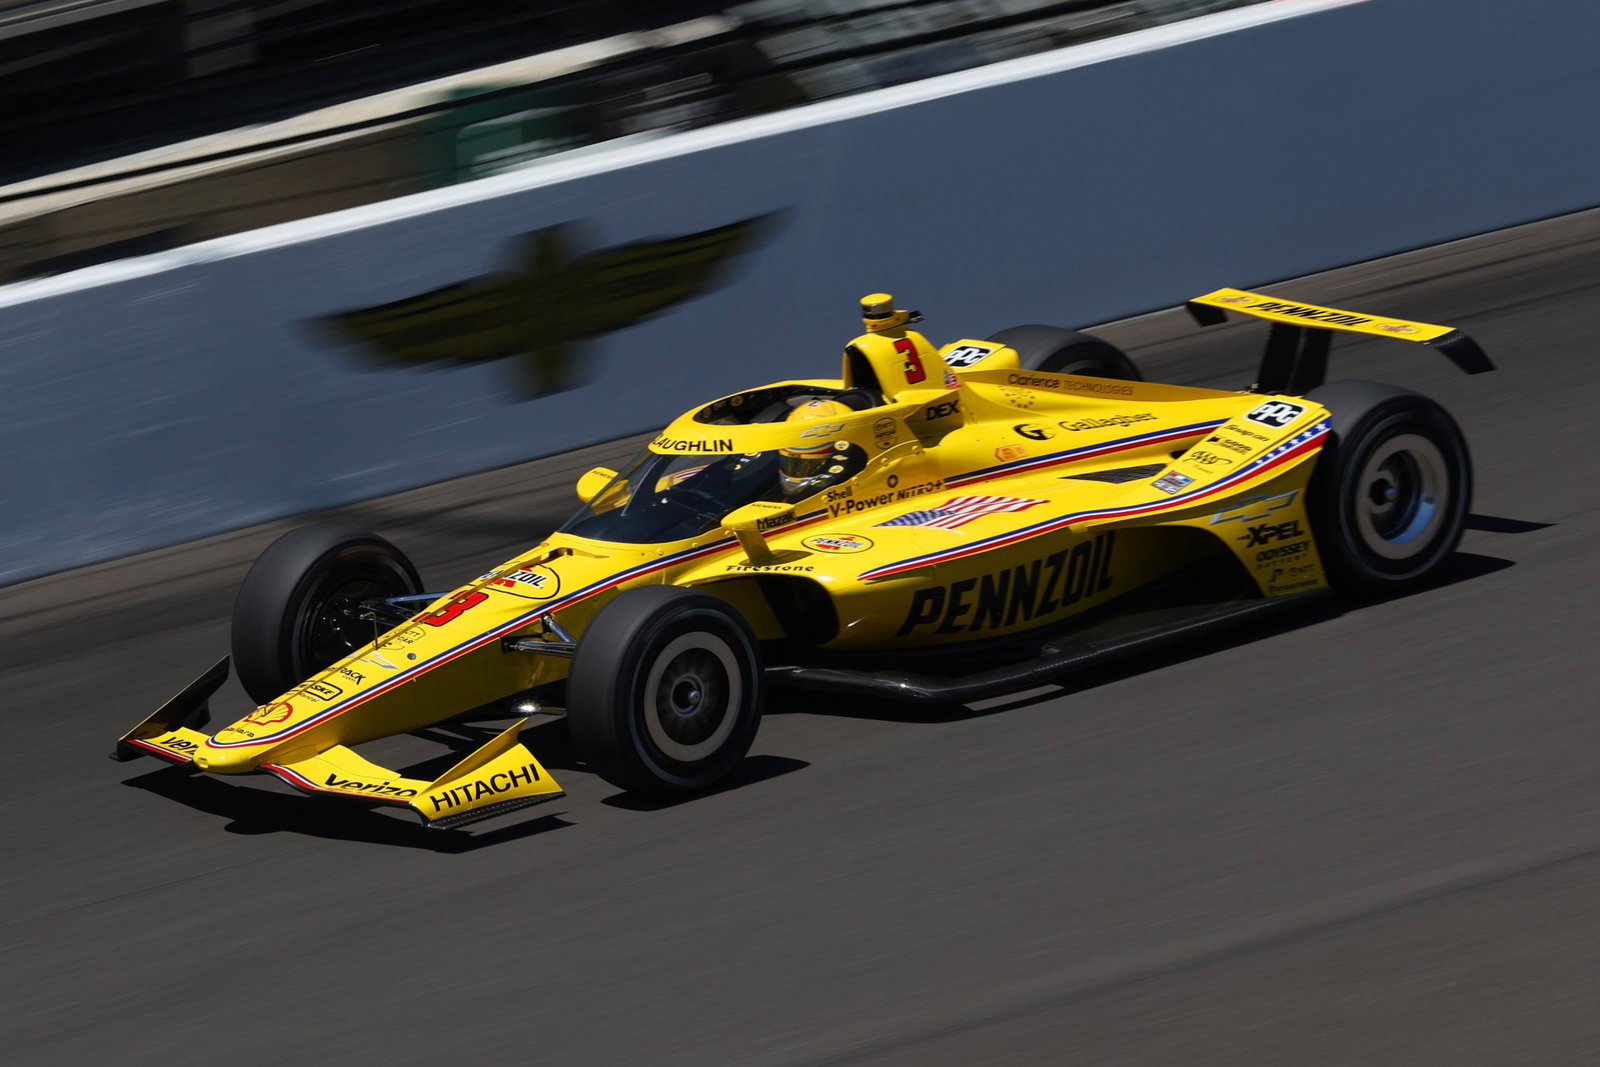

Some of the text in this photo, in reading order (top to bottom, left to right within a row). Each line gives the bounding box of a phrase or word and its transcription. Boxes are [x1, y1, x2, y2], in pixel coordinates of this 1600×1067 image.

[1244, 302, 1373, 326] PENNZOIL
[894, 338, 926, 385] 3
[943, 348, 987, 365] PPG
[926, 399, 960, 421] DEX
[1251, 402, 1300, 424] PPG
[1058, 413, 1158, 432] Gallagher
[827, 486, 853, 502] Shell
[829, 493, 895, 518] V-Power
[757, 511, 796, 530] Mazak
[896, 530, 1114, 637] PENNZOIL
[411, 589, 489, 627] 3
[160, 737, 199, 755] ver
[324, 773, 418, 797] verizo
[429, 763, 540, 812] HITACHI
